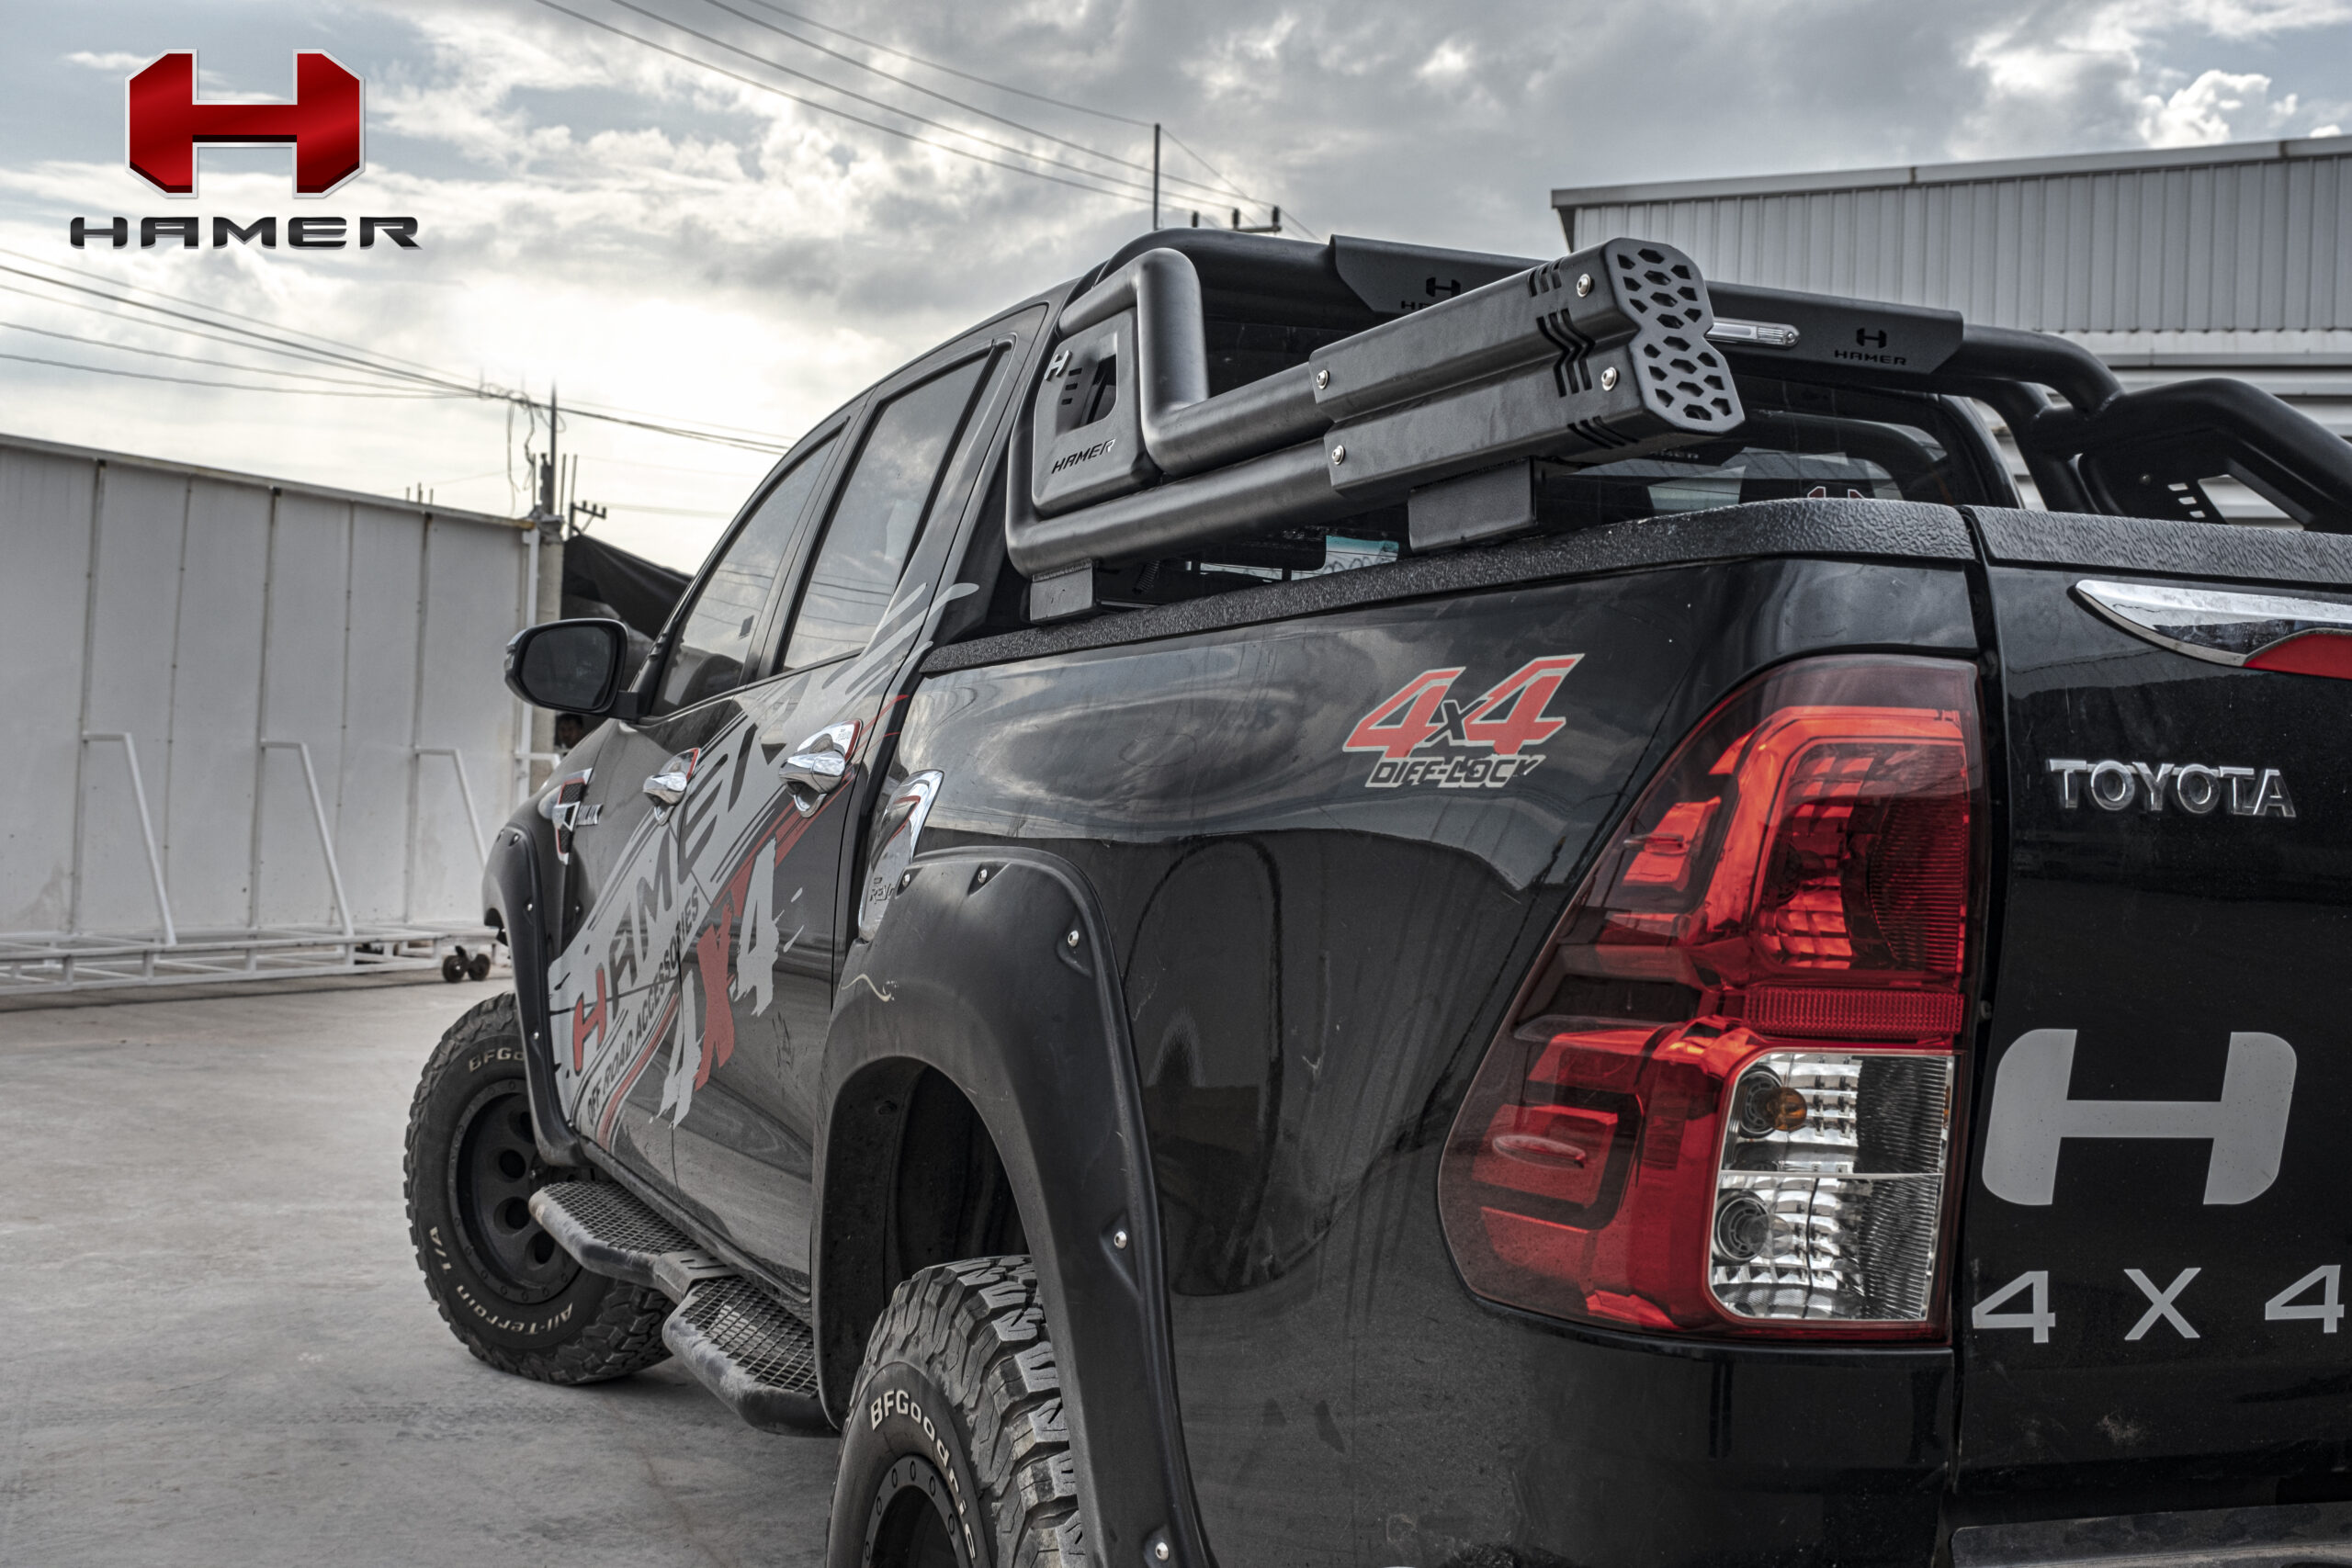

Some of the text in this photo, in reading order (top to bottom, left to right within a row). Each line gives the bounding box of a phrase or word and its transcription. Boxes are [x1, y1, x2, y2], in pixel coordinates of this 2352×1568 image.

[1834, 350, 1906, 366] HAMER
[1051, 438, 1115, 474] HAMER
[1365, 755, 1546, 787] DIFF-LOCK
[2049, 760, 2296, 818] TOYOTA
[587, 886, 698, 1126] OFF ROAD ACCESSORIES
[429, 1226, 452, 1274] T/A
